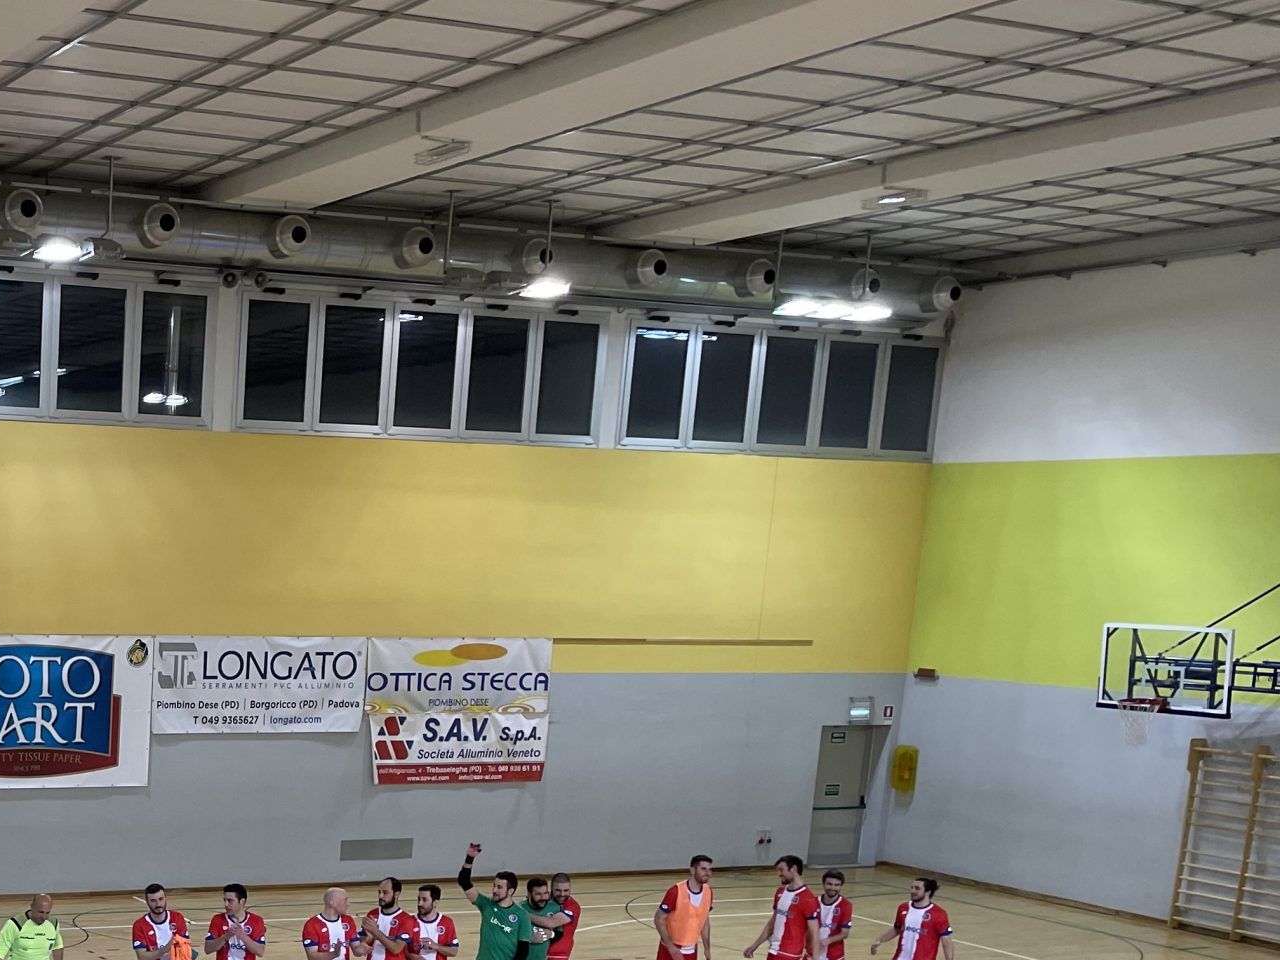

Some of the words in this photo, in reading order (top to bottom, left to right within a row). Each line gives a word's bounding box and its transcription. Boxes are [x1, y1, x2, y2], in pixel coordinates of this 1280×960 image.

[202, 650, 358, 681] LONGATO
[202, 682, 268, 690] SERRAMENTI
[273, 682, 292, 690] PVC
[297, 681, 355, 689] ALLUMINIO
[367, 672, 452, 692] OTTICA
[461, 672, 549, 692] STECCA
[156, 700, 196, 710] Piombino
[198, 700, 219, 710] Dese
[221, 700, 240, 710] (PD)
[249, 699, 297, 711] Borgoricco
[299, 699, 318, 710] (PD)
[327, 699, 360, 709] Padova
[428, 698, 469, 707] PIOMBINO
[470, 698, 489, 706] DESE
[193, 715, 199, 725] T
[201, 715, 220, 725] 049
[222, 715, 259, 725] 9365627
[269, 715, 322, 726] longato.com
[422, 717, 489, 742] S.A.V.
[499, 726, 542, 746] S.p.A.
[18, 751, 50, 762] TISSUE
[53, 752, 82, 764] PAPER
[456, 747, 503, 760] Alluminio
[506, 748, 541, 758] Veneto
